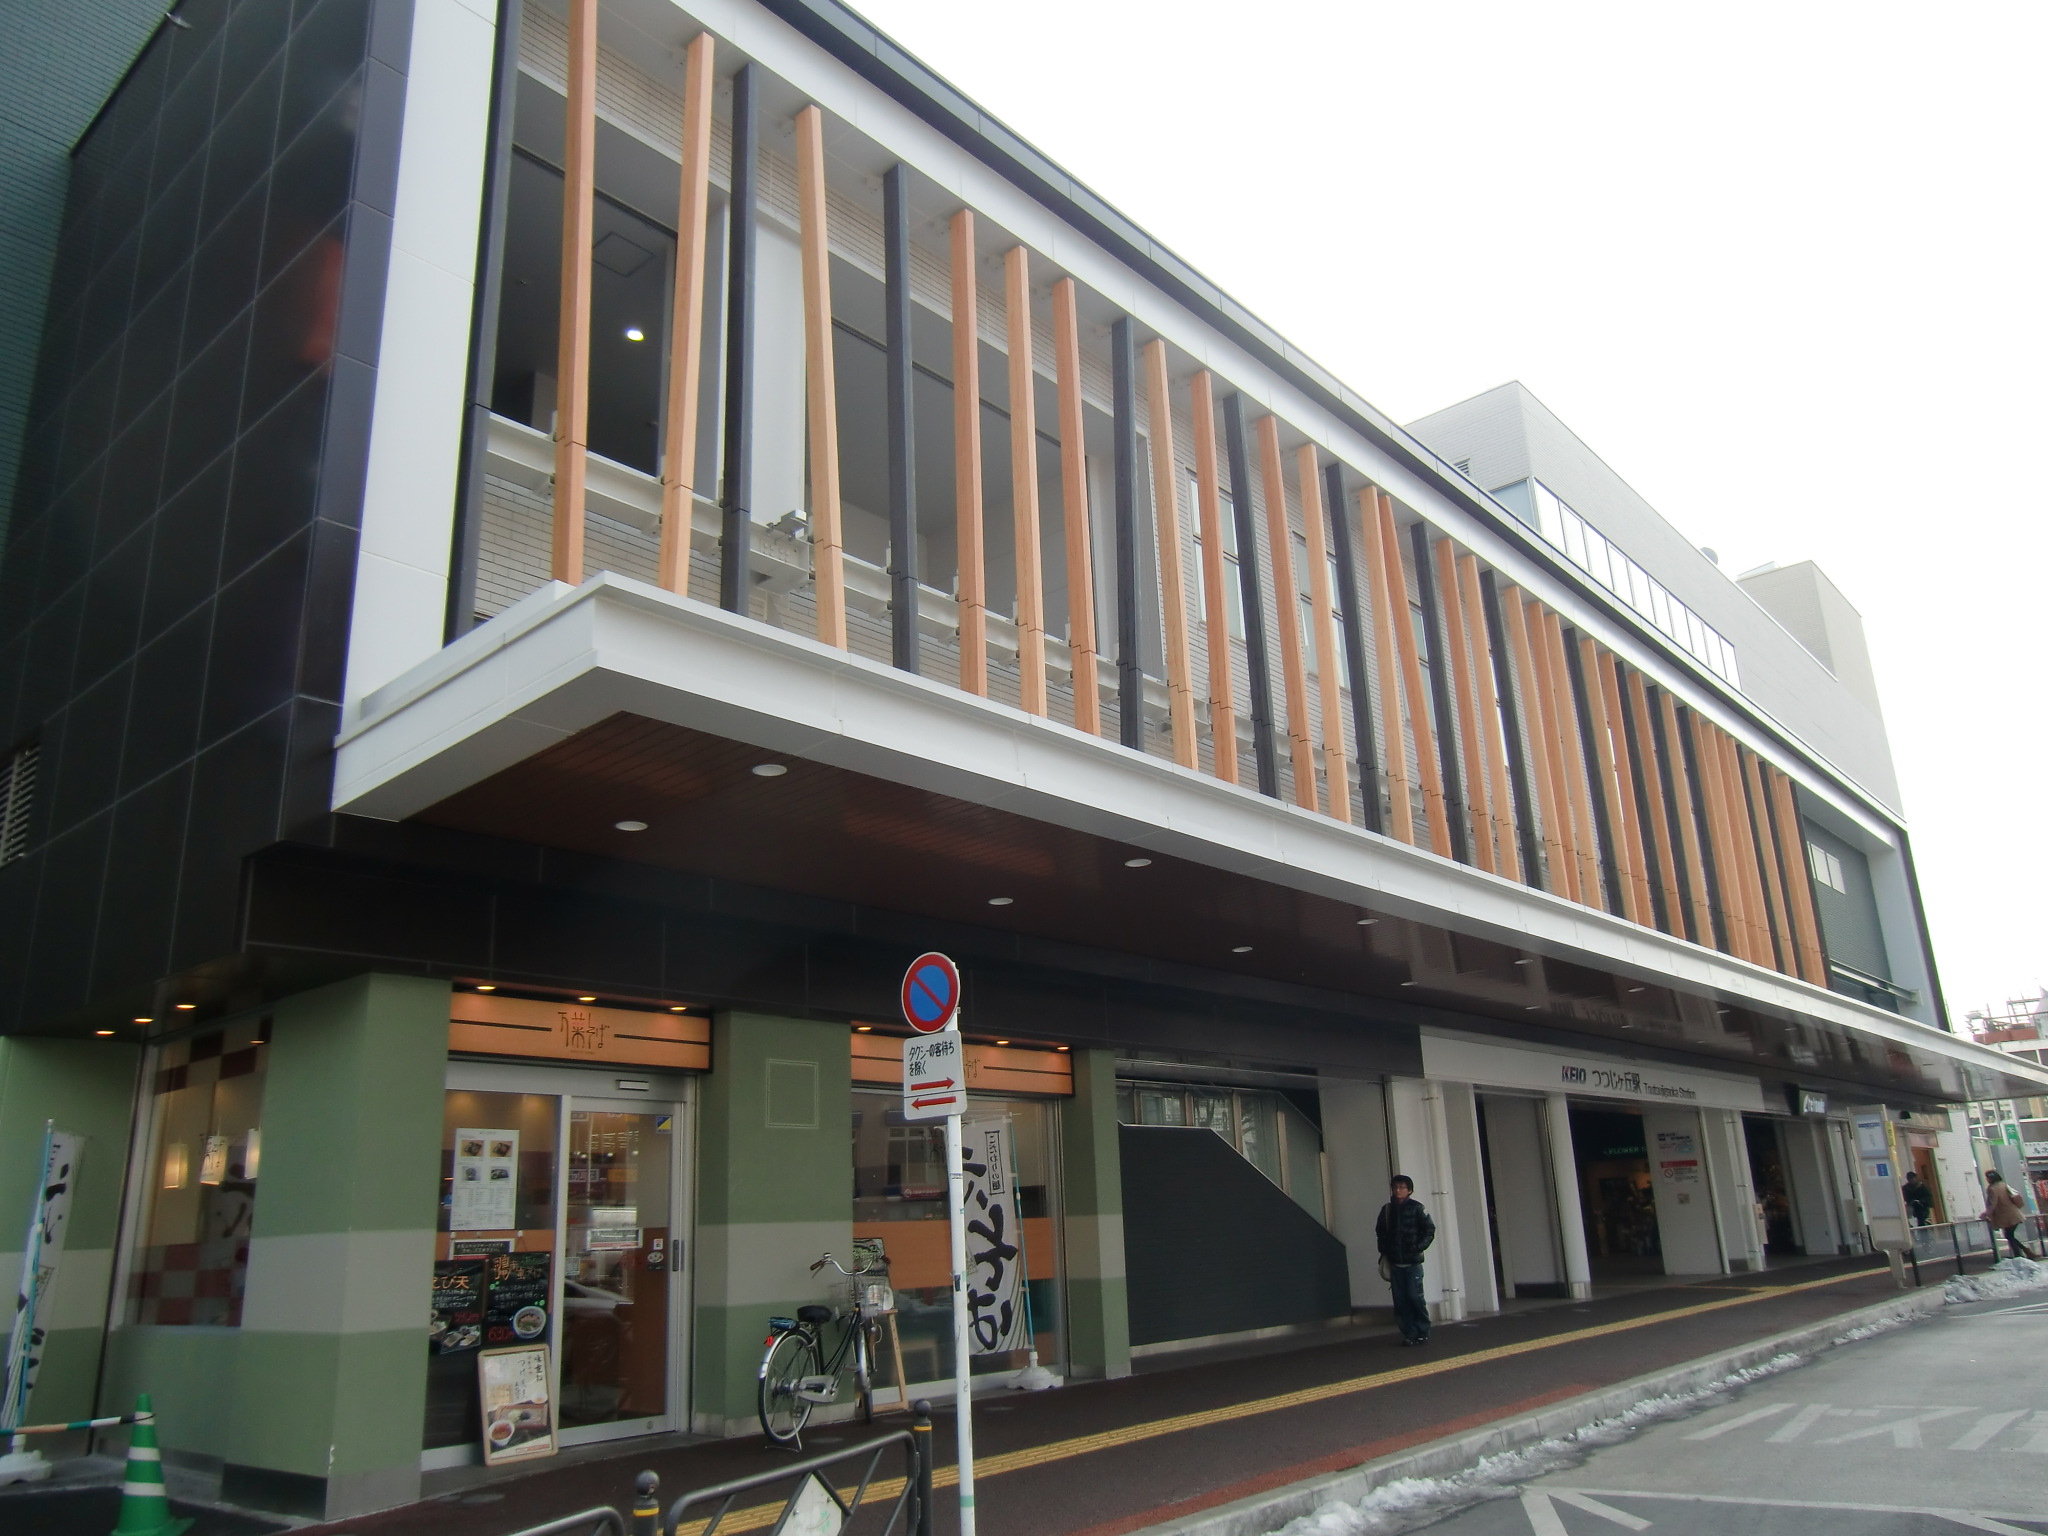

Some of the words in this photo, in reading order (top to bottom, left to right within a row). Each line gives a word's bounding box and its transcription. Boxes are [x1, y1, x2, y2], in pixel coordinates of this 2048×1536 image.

[909, 1040, 955, 1061] タクシーの客待ち
[909, 1060, 927, 1077] を除く
[1561, 1065, 1587, 1084] KEIO
[1592, 1069, 1642, 1094] つつじヶ丘駅
[1679, 1087, 1697, 1100] Station
